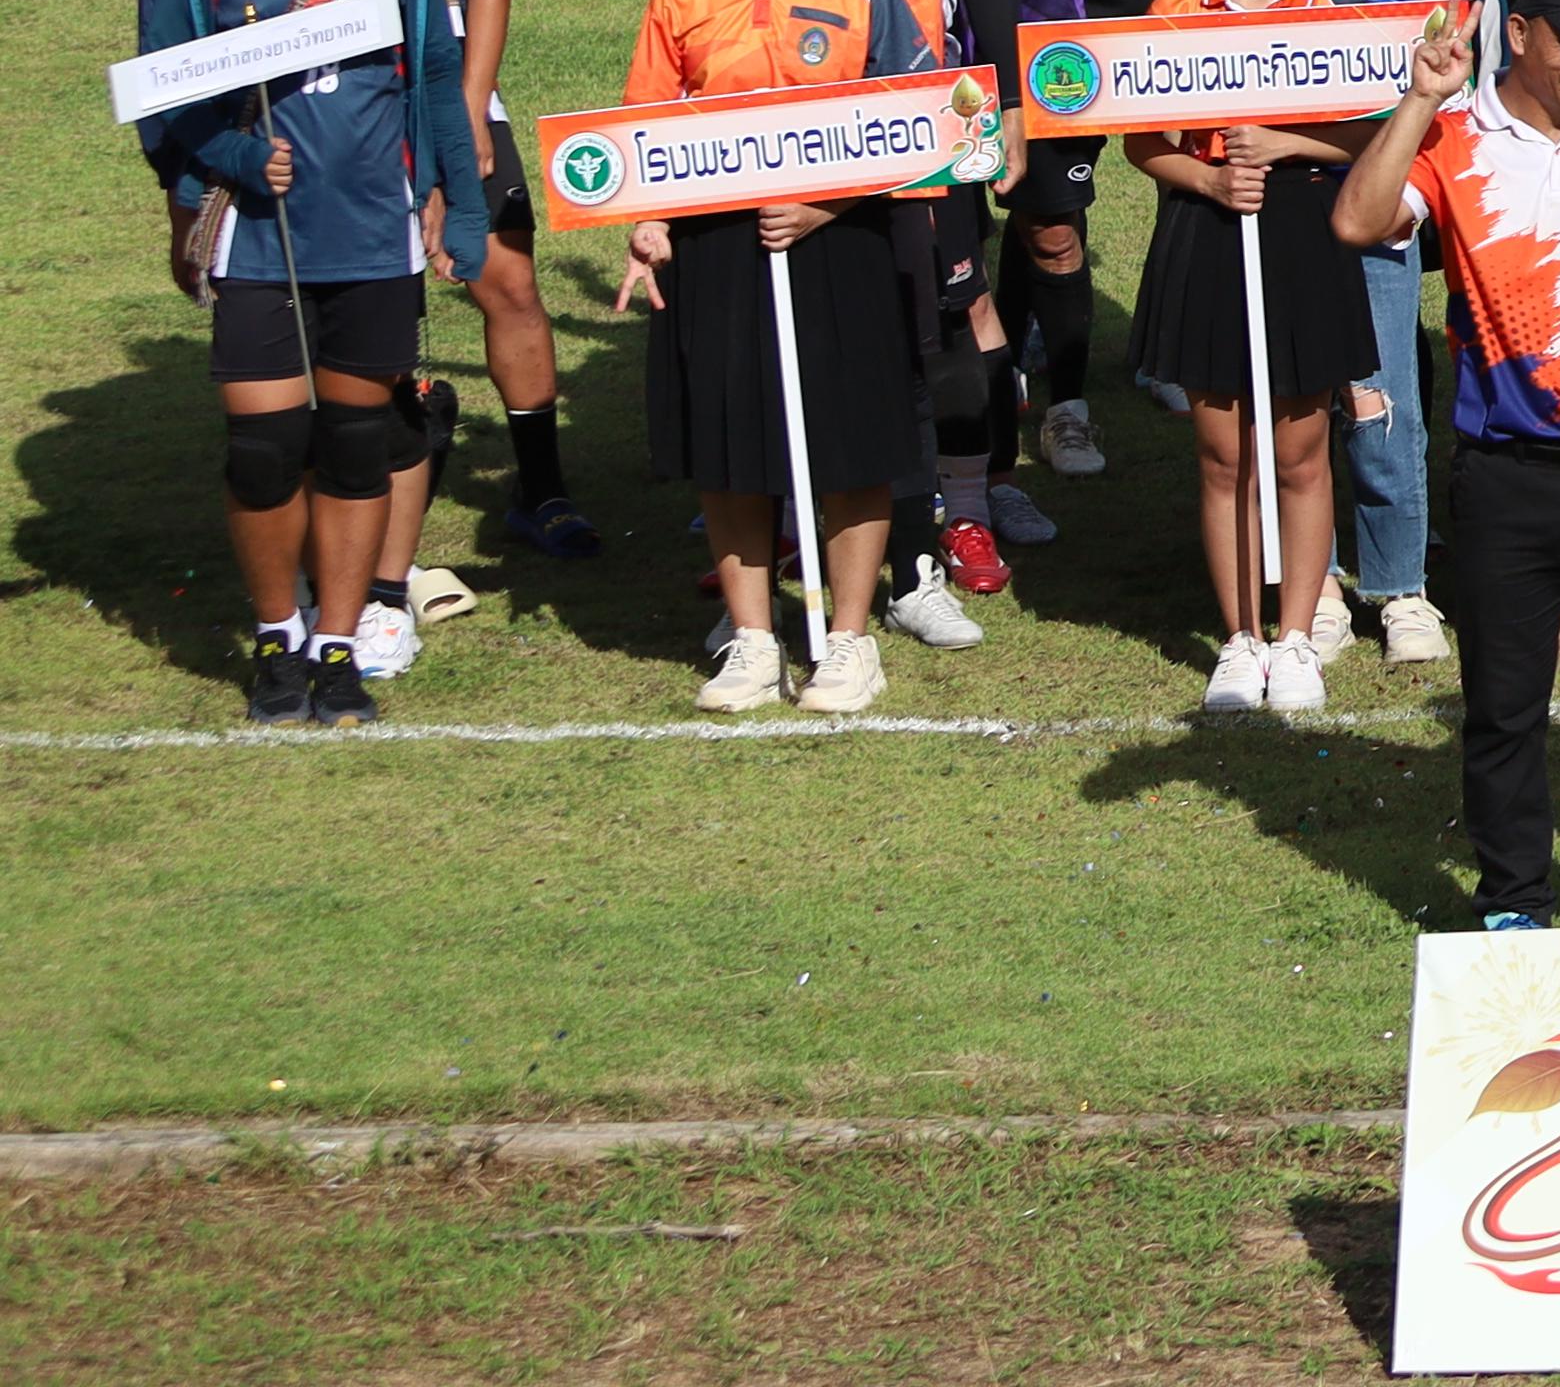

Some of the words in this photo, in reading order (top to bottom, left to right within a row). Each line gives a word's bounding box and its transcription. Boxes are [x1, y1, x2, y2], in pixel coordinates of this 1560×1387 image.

[149, 16, 368, 88] โรงเรียนท่าสองยางวิทยาคม
[1112, 42, 1410, 97] หน่วยเฉพาะกิจราชมนู
[635, 110, 937, 184] โรงพยาบาลแม่สอด
